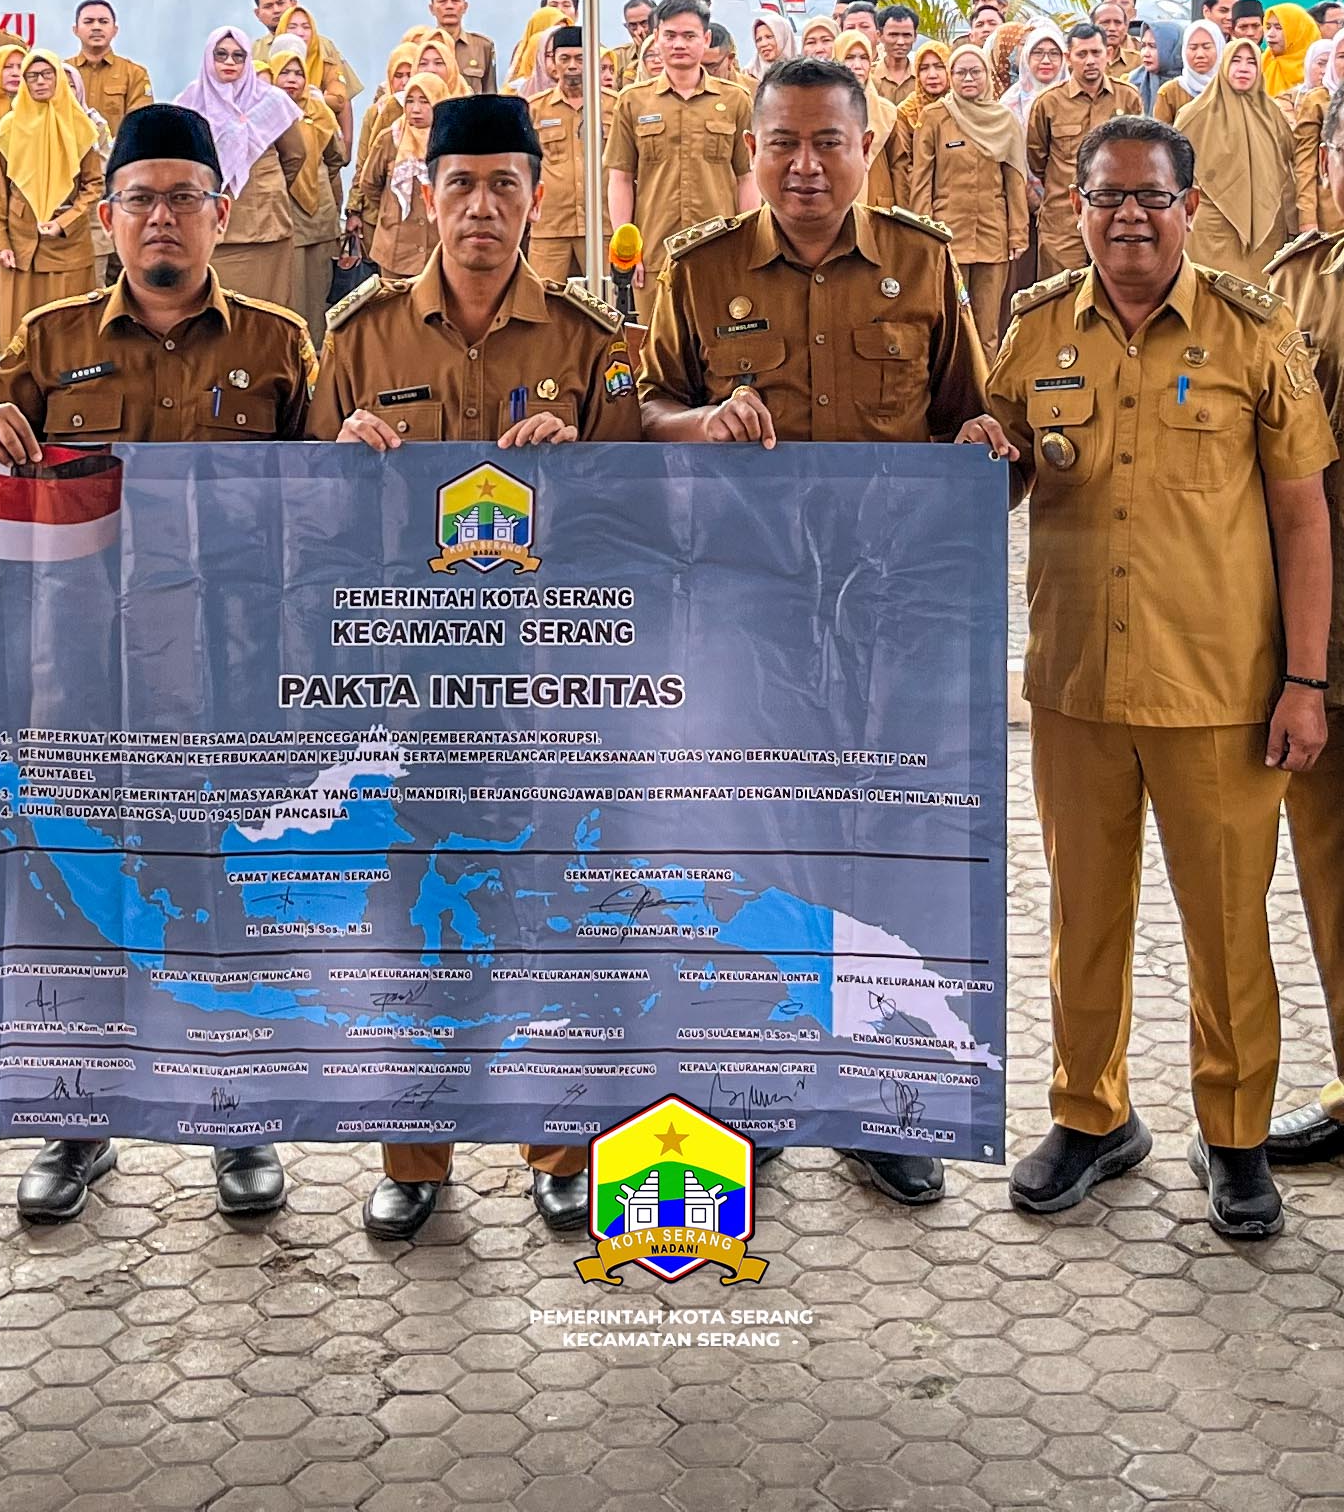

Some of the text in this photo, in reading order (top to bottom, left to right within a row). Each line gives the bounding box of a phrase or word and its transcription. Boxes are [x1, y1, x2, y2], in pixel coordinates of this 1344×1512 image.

[334, 587, 633, 609] PEMERINTAH KOTA SERANG
[332, 620, 634, 645] KECAMATAN SERANG
[279, 674, 686, 709] PAKTA INTEGRITAS
[18, 730, 105, 745] MEMPERKUAT
[109, 732, 179, 746] KOMITMEN
[183, 732, 246, 746] BERSAMA
[250, 732, 294, 745] DALAM
[298, 731, 388, 745] PENCEGAHAN
[392, 732, 418, 745] DAN
[422, 732, 536, 745] PEMBERANTASAN
[540, 732, 601, 745] KORUPSI.
[18, 749, 183, 765] MENUMBUHKEMBANGKAN
[187, 750, 286, 765] KETERBUKAAN
[290, 751, 316, 764] DAN
[320, 750, 399, 764] KEJUJURAN
[403, 750, 445, 764] SERTA
[449, 750, 556, 764] MEMPERLANCAR
[560, 750, 655, 764] PELAKSANAAN
[660, 751, 703, 763] TUGAS
[707, 751, 742, 763] YANG
[746, 751, 839, 766] BERKUALITAS,
[843, 751, 895, 765] EFEKTIF
[900, 754, 927, 767] DAN
[18, 767, 95, 781] AKUNTABEL
[18, 786, 110, 800] MEWUJUDKAN
[114, 789, 196, 802] PEMERINTAH
[199, 790, 226, 802] DAN
[230, 789, 318, 801] MASYARAKAT
[322, 789, 358, 801] YANG
[362, 789, 402, 803] MAJU,
[406, 789, 467, 804] MANDIRI,
[617, 789, 644, 801] DAN
[647, 789, 734, 801] BERMANFAAT
[737, 789, 791, 801] DENGAN
[795, 789, 863, 801] DILANDASI
[867, 791, 902, 803] OLEH
[18, 805, 62, 817] LUHUR
[65, 806, 117, 819] BUDAYA
[120, 808, 176, 824] BANGSA,
[178, 809, 207, 821] UUD
[210, 809, 241, 821] 1945
[244, 809, 271, 820] DAN
[275, 807, 348, 819] PANCASILA
[228, 869, 391, 884] CAMAT KECAMATAN SERANG
[564, 869, 733, 881] SEKMAT KECAMATAN SERANG
[576, 925, 618, 938] AGUNG
[32, 965, 91, 978] KELURAHAN
[151, 969, 311, 983] KEPALA KELURAHAN CIMUNCANG
[329, 969, 473, 981] KEPALA KELURAHAN SERANG
[491, 969, 650, 981] KEPALA KELURAHAN SUKAWANA
[678, 970, 820, 983] KEPALA KELURAHAN LONTAR
[836, 974, 994, 992] KEPALA KELURAHAN KOTA BARU
[516, 1027, 566, 1039] MUHAMAD
[677, 1028, 706, 1040] AGUS
[852, 1033, 892, 1046] ENDANG
[22, 1057, 83, 1069] KELURAHAN
[153, 1062, 190, 1074] KEPALA
[191, 1064, 250, 1077] KELURAHAN
[323, 1063, 471, 1076] KEPALA KELURAHAN KALIGANDU
[679, 1063, 716, 1074] KEPALA
[719, 1063, 779, 1074] KELURAHAN
[489, 1064, 656, 1076] KEPALA KELURAHAN SUMUR PECUNG
[839, 1065, 981, 1086] KEPALA KELURAHAN LOPANG
[196, 1122, 226, 1134] YUDHI
[337, 1121, 363, 1132] AGUS
